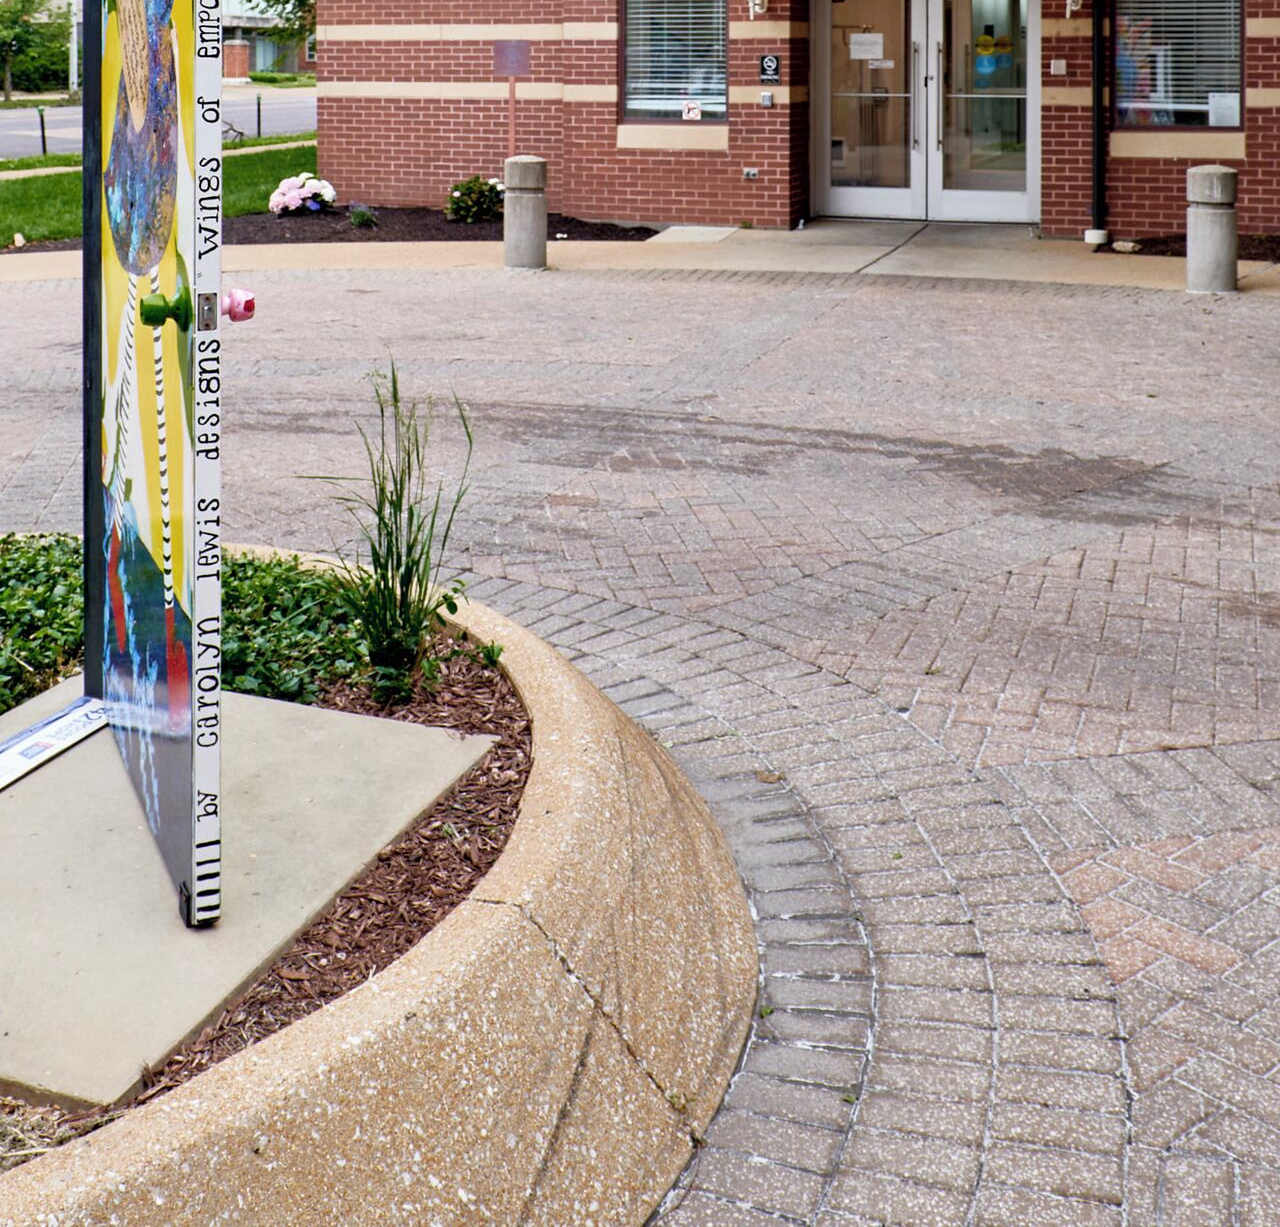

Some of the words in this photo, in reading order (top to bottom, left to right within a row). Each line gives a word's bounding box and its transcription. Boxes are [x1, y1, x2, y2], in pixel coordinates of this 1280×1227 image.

[196, 96, 221, 124] of
[195, 339, 221, 461] designs
[196, 497, 221, 582] lewis
[196, 789, 220, 822] by
